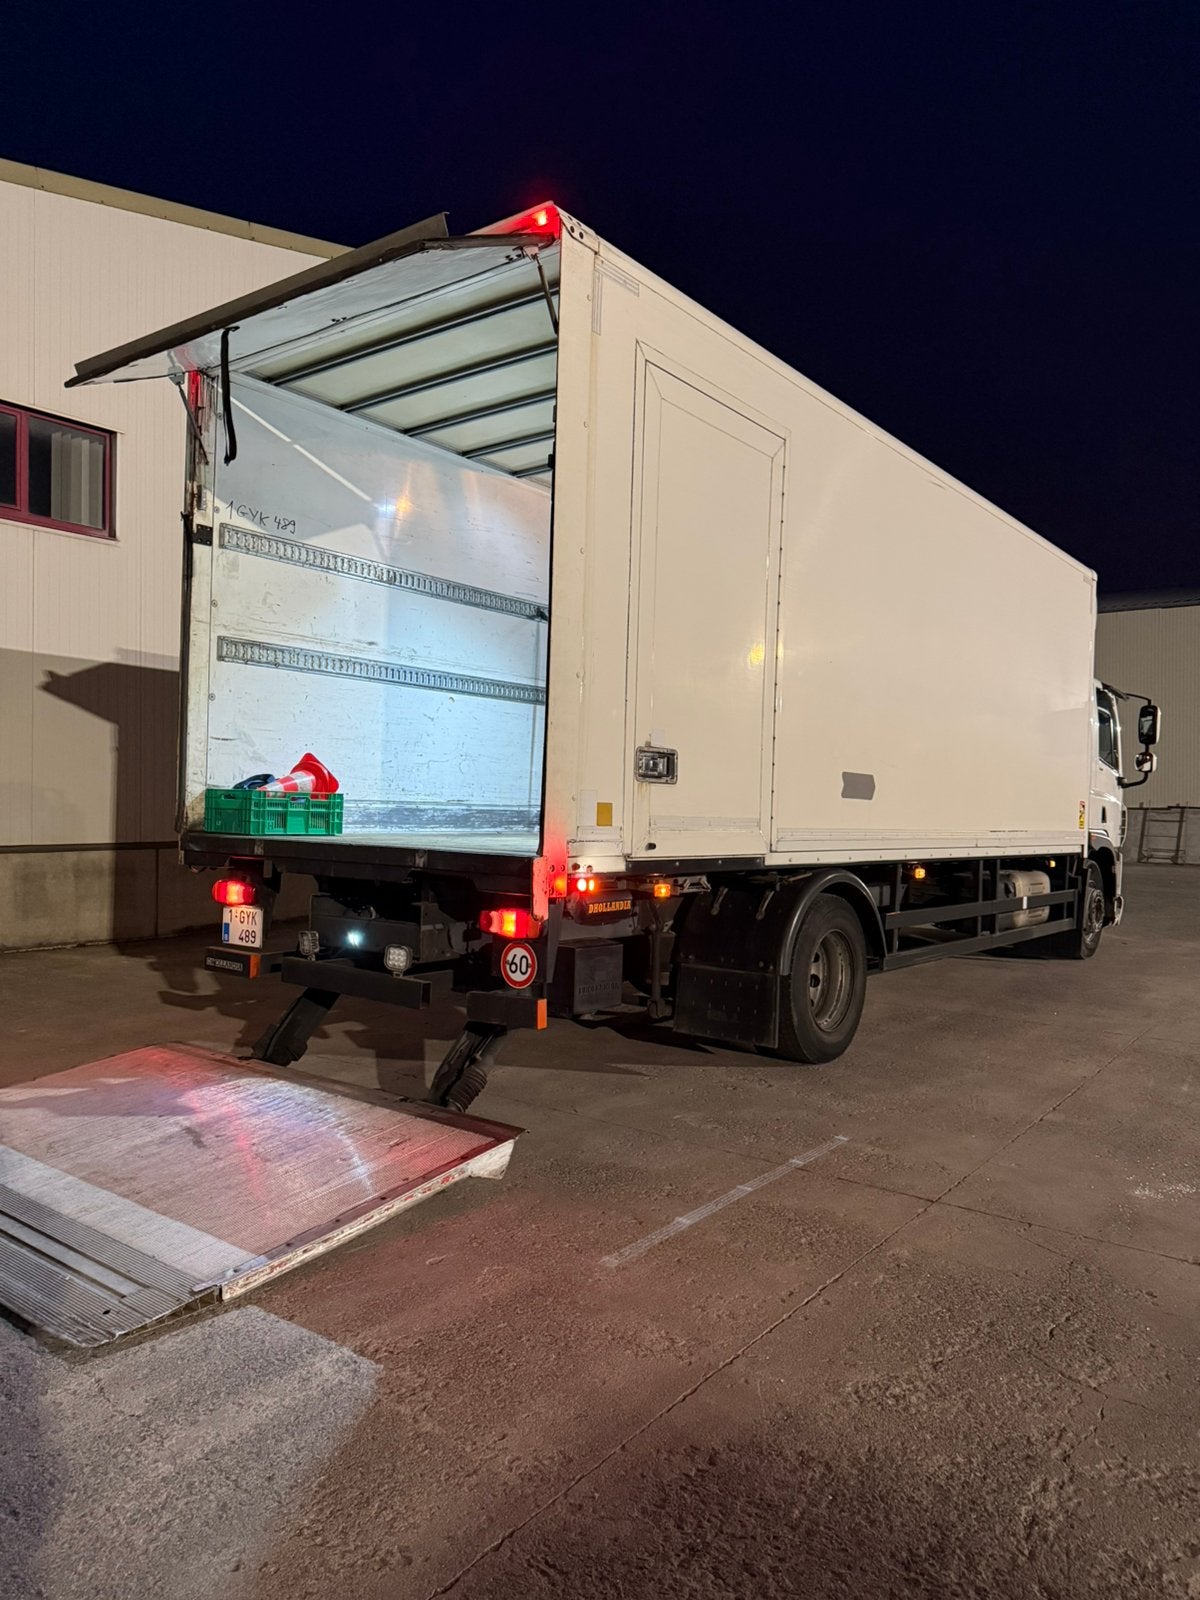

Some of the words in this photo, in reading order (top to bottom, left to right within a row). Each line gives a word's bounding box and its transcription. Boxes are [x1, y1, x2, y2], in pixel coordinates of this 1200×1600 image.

[274, 516, 296, 534] 489
[588, 900, 631, 913] DHOLLANDIA
[238, 929, 256, 944] 489
[509, 954, 529, 975] 60
